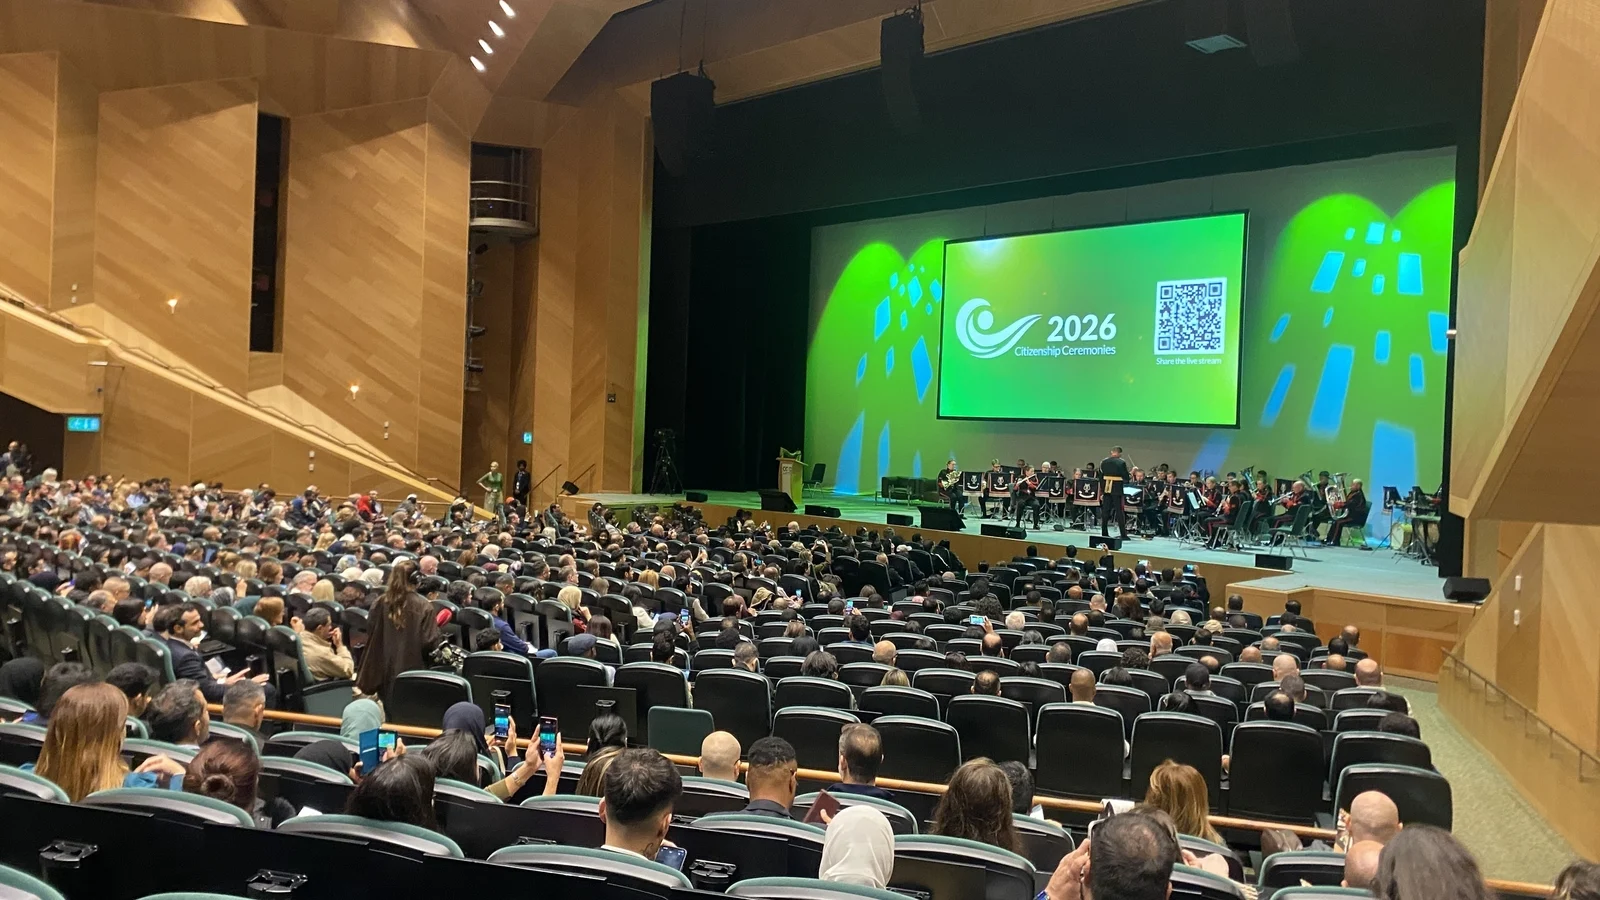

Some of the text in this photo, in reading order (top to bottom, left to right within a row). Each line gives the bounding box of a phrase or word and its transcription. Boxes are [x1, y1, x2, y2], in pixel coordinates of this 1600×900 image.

[1047, 313, 1117, 342] 2026
[1014, 345, 1116, 358] Citizenship Ceremonies
[1156, 357, 1222, 365] Share the live stream
